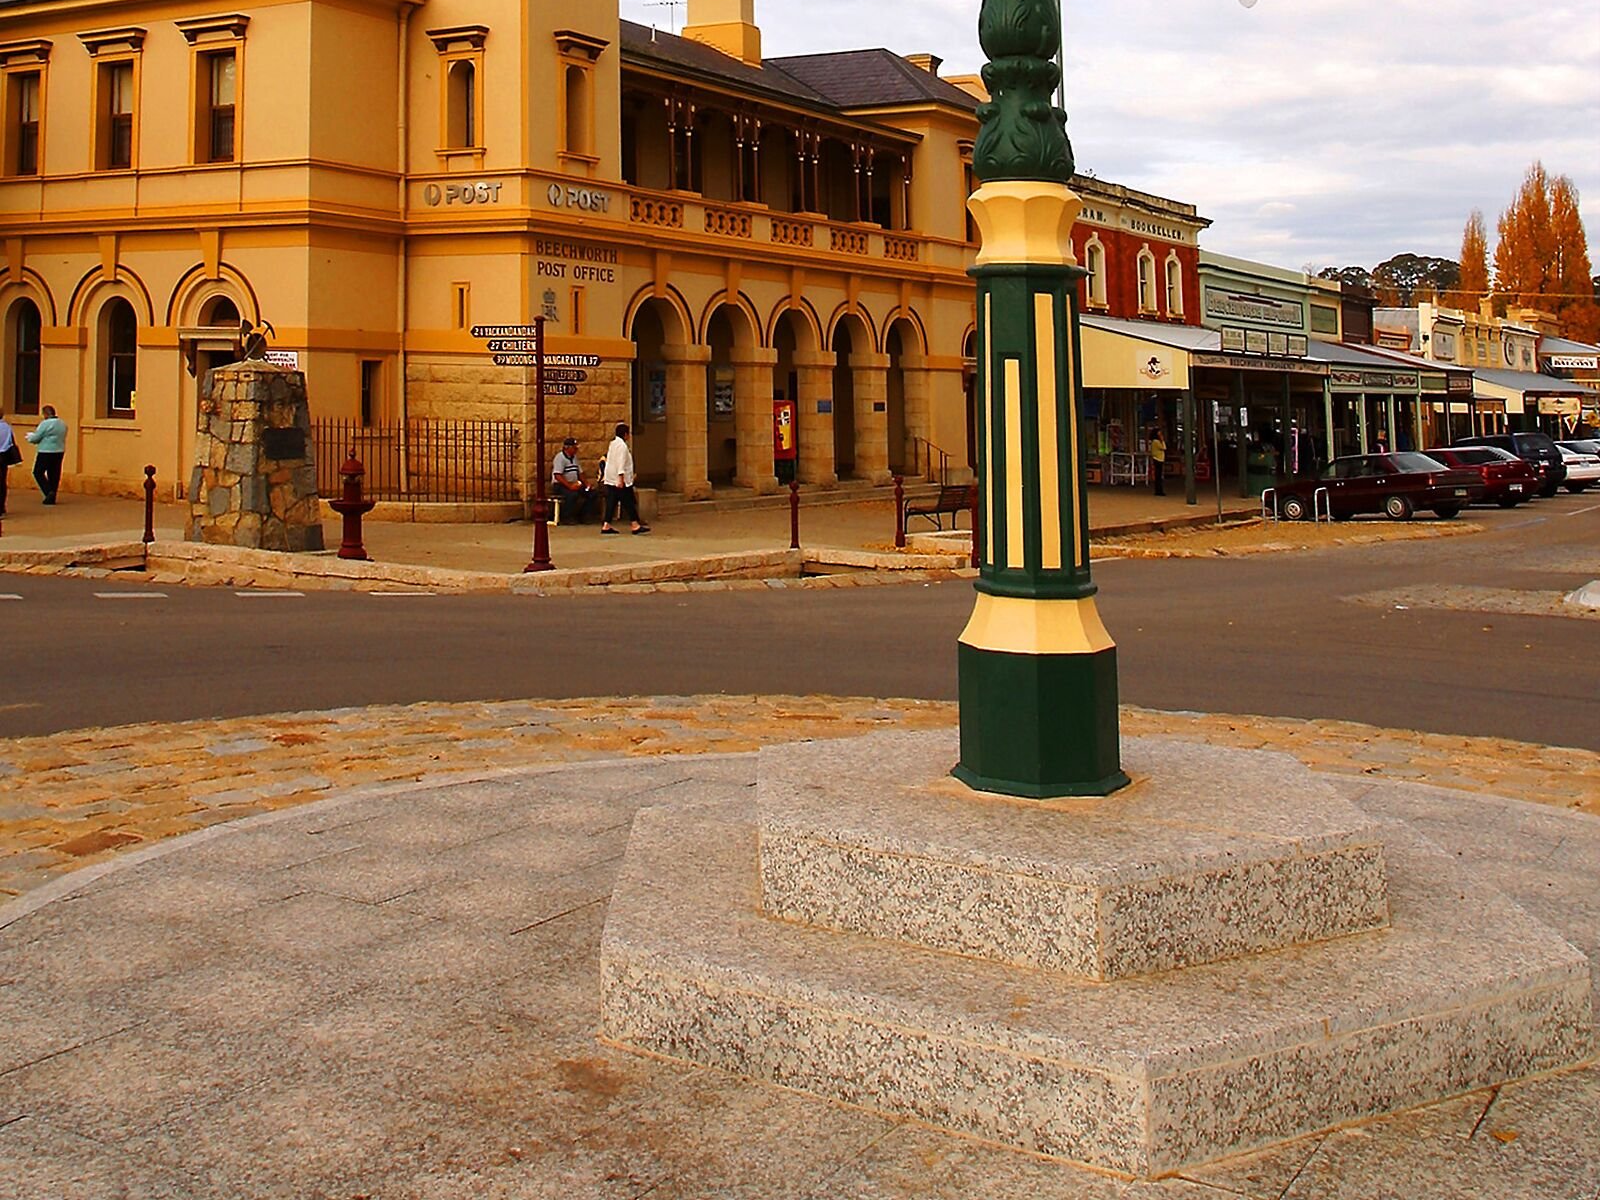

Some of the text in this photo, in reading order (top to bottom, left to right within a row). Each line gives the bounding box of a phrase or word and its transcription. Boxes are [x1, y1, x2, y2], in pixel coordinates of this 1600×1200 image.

[446, 182, 502, 204] POST
[566, 187, 609, 213] POST
[536, 240, 617, 264] BEECHWORTH
[537, 261, 615, 283] POST OFFICE
[490, 341, 536, 350] 27 CHILTERN
[543, 355, 598, 365] WANGARATTA 37
[544, 385, 566, 394] STANLEY
